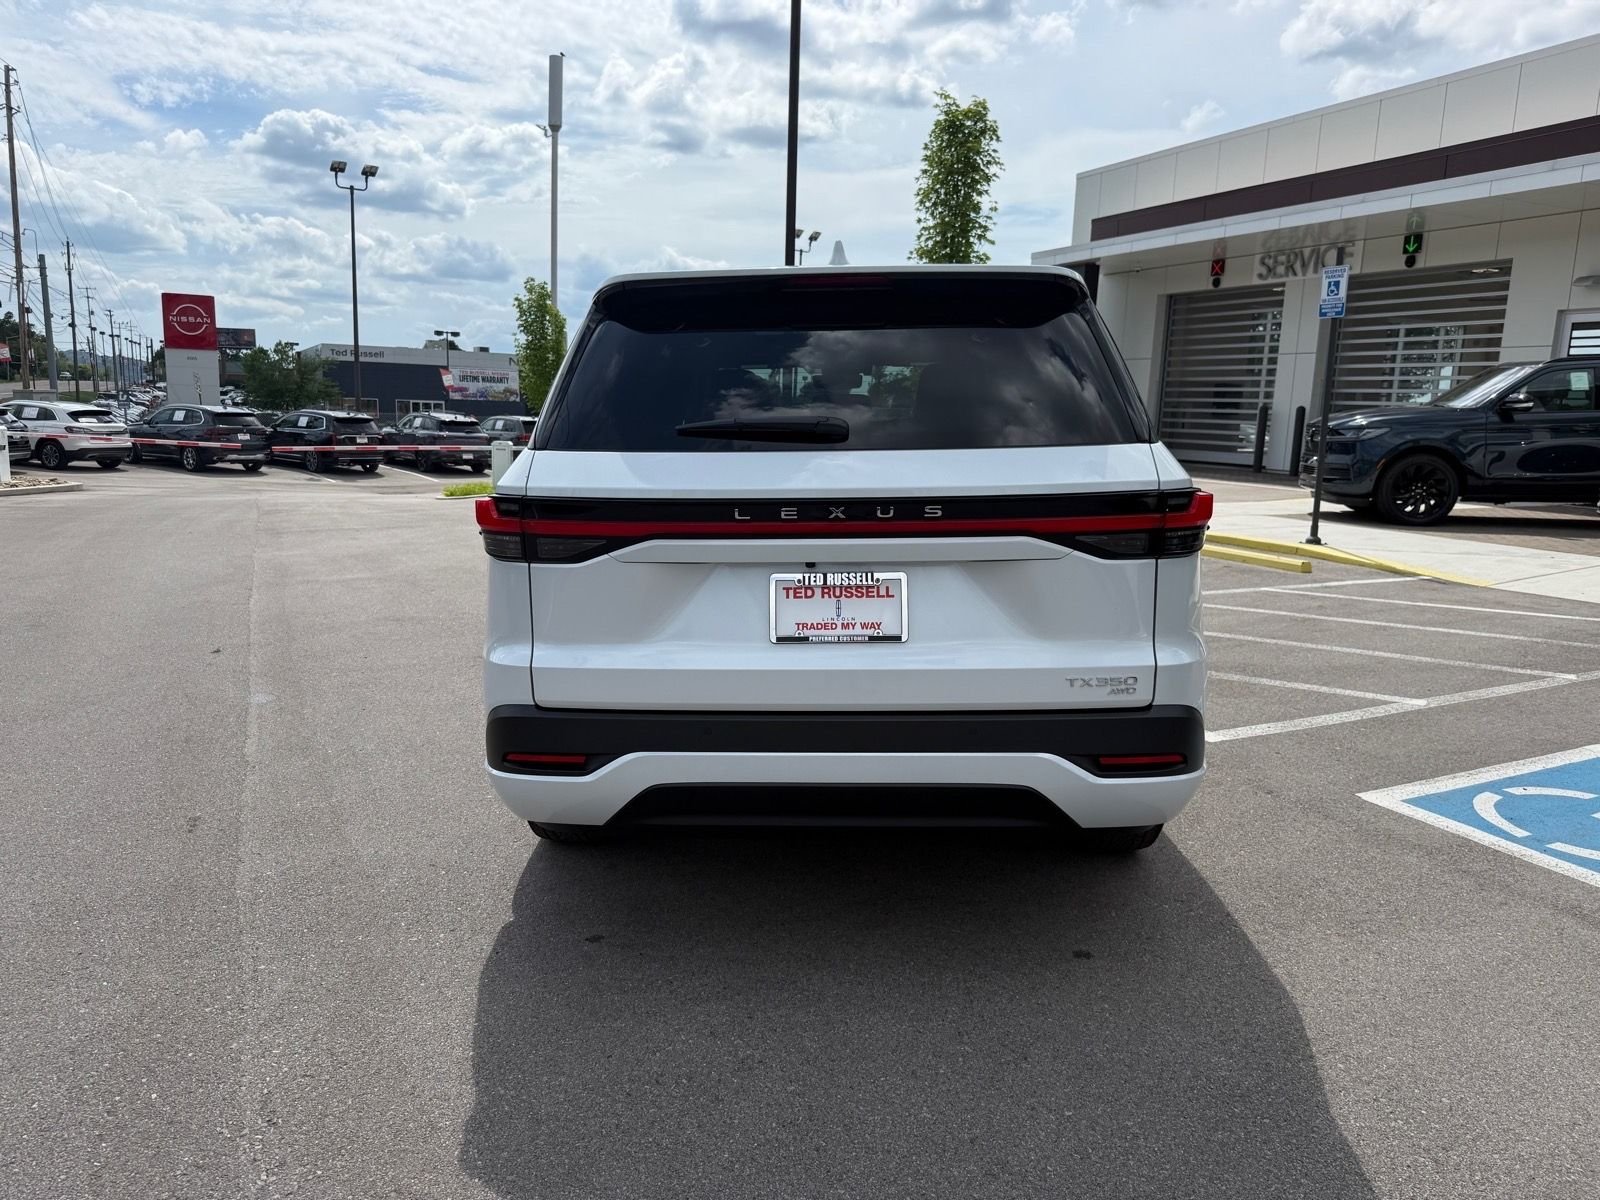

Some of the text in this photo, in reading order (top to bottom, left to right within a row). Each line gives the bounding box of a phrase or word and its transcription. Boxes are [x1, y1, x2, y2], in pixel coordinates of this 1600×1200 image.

[1257, 242, 1356, 280] SERVICE
[169, 315, 211, 324] NISSAN
[330, 348, 348, 357] Ted
[459, 375, 510, 385] LIFETIME WARRANTY
[734, 505, 943, 520] LEXUS
[803, 572, 875, 586] TED RUSSELL
[782, 586, 895, 599] TED RUSSELL
[795, 621, 883, 631] TRADED MY WAY
[1065, 676, 1138, 688] TX350
[1107, 687, 1137, 696] AWD
